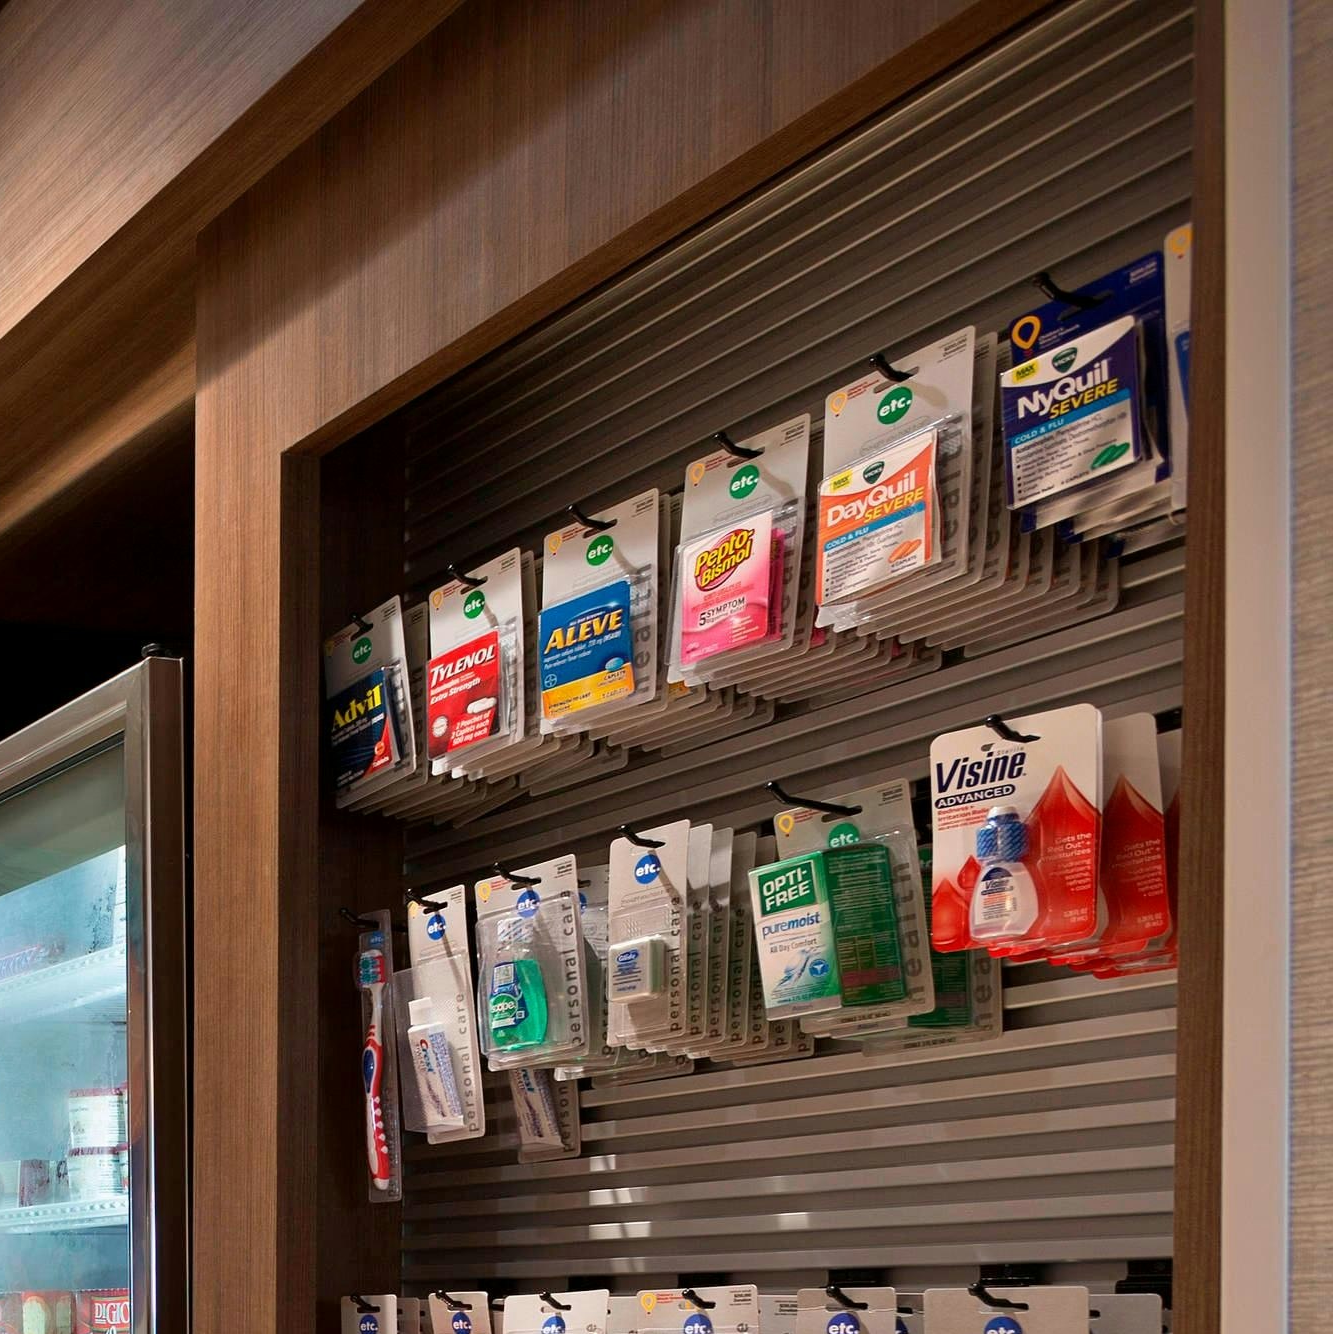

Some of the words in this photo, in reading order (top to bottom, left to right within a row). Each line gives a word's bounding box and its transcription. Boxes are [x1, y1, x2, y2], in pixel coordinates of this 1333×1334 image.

[1018, 359, 1109, 419] NyQuil
[1049, 378, 1119, 420] SEVERE
[879, 397, 912, 417] etc.
[1014, 428, 1038, 444] COLD
[1039, 426, 1046, 435] &
[1048, 418, 1064, 430] FLU
[732, 478, 759, 493] etc.
[827, 469, 917, 527] DayQuil
[863, 487, 924, 523] SEVERE
[588, 543, 612, 559] etc.
[695, 529, 755, 577] Pepto-
[826, 536, 846, 549] COLD
[854, 527, 869, 537] FLU
[701, 541, 752, 589] Bismol
[465, 598, 485, 613] etc.
[699, 611, 707, 627] 5
[707, 597, 745, 618] SYMPTOM
[544, 609, 624, 654] ALEVE
[635, 564, 652, 694] health
[353, 643, 372, 658] etc.
[431, 645, 496, 688] TYLENOL
[333, 684, 382, 728] Advil
[431, 692, 448, 705] Extra
[449, 677, 481, 697] Strength
[936, 750, 1027, 793] Visine
[937, 785, 1013, 808] ADVANCED
[937, 805, 969, 816] Redness
[830, 832, 860, 848] etc.
[1077, 832, 1092, 840] the
[635, 863, 661, 877] etc.
[762, 867, 808, 897] OPTI-
[518, 898, 540, 911] etc.
[765, 883, 811, 912] FREE
[560, 890, 575, 937] care
[670, 897, 681, 937] care
[692, 901, 702, 941] care
[734, 908, 745, 948] care
[762, 911, 821, 939] puremoist
[428, 923, 447, 935] etc.
[893, 862, 926, 1004] health
[770, 943, 780, 953] All
[790, 937, 818, 951] Comfort
[562, 949, 584, 1046] personal
[669, 948, 682, 1032] personal
[689, 951, 702, 1036] personal
[709, 954, 721, 1038] personal
[731, 958, 743, 1042] personal
[459, 992, 468, 1035] care
[461, 1047, 480, 1132] personal
[360, 1322, 379, 1331] etc.
[453, 1320, 472, 1330] etc.
[543, 1324, 565, 1334] etc.
[685, 1323, 711, 1334] etc.
[828, 1321, 859, 1334] etc.
